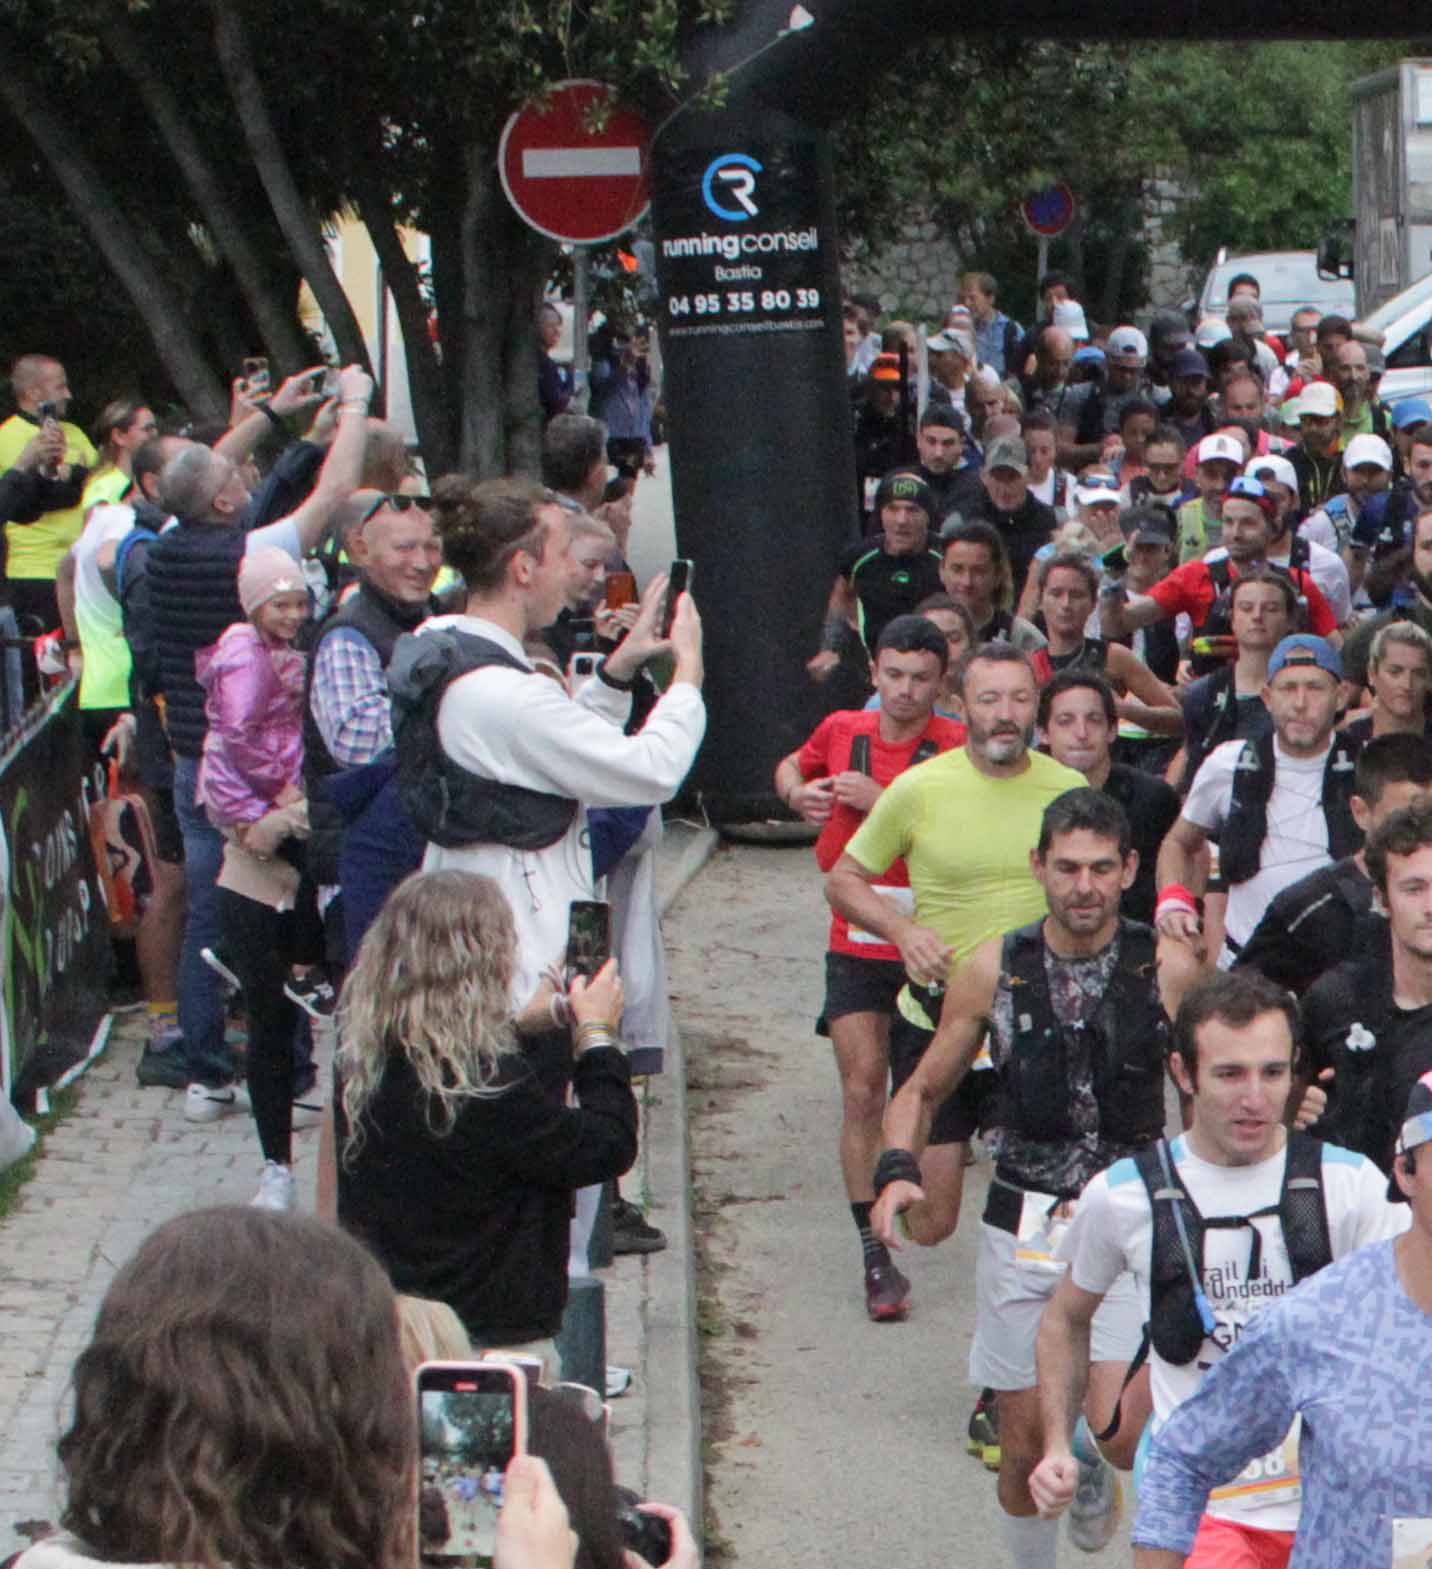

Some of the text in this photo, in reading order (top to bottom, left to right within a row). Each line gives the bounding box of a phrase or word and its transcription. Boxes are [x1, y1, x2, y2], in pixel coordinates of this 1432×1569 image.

[714, 264, 763, 282] Bastia
[668, 288, 820, 316] 04 95 35 80 39
